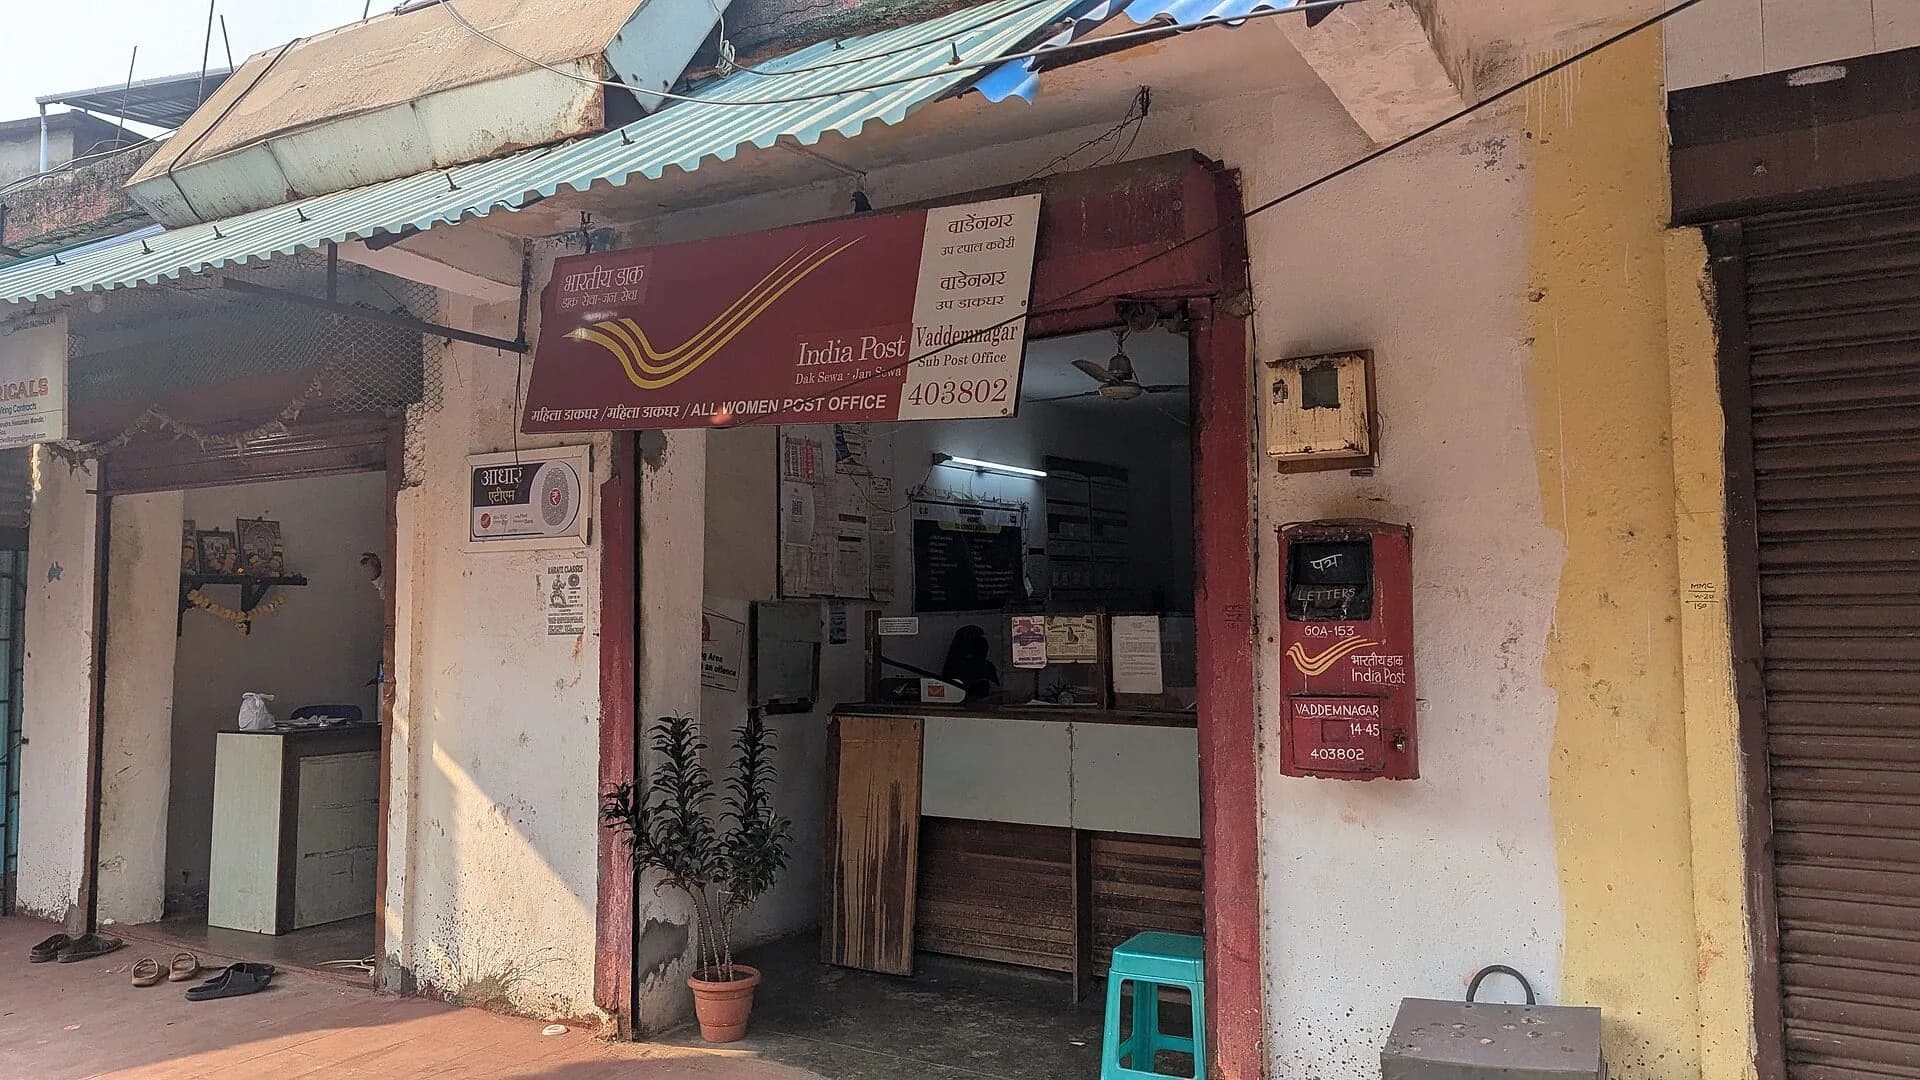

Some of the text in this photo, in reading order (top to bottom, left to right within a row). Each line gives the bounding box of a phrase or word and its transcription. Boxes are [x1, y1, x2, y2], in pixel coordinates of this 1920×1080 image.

[940, 246, 954, 256] उप
[957, 242, 982, 254] टपाल
[564, 265, 645, 292] भारतीय डाक
[940, 271, 1007, 290] वाडेनगर
[561, 297, 579, 308] डाक
[620, 287, 638, 302] सेवा
[935, 295, 1006, 310] उप डाकघर
[796, 335, 906, 367] India Post
[918, 352, 1007, 368] Sub Post Office
[795, 372, 814, 385] Dak
[817, 371, 843, 383] Sewa
[852, 368, 872, 380] Jan
[908, 379, 1008, 405] 403802
[531, 407, 562, 422] महिला
[563, 408, 600, 421] डाकघर
[642, 405, 680, 419] डाकघर
[722, 399, 779, 415] WOMEN
[782, 397, 825, 413] POST
[828, 394, 887, 411] OFFICE
[480, 466, 523, 487] आधार
[488, 486, 515, 505] एटीएम
[1310, 553, 1343, 571] पत्र
[1297, 587, 1356, 601] LETTERS
[1304, 624, 1355, 636] GOA-153
[1350, 651, 1404, 666] भारतीय डाक
[1351, 667, 1406, 684] India Post
[1294, 703, 1379, 717] VADDEMNAGAR
[1310, 748, 1365, 760] 403802
